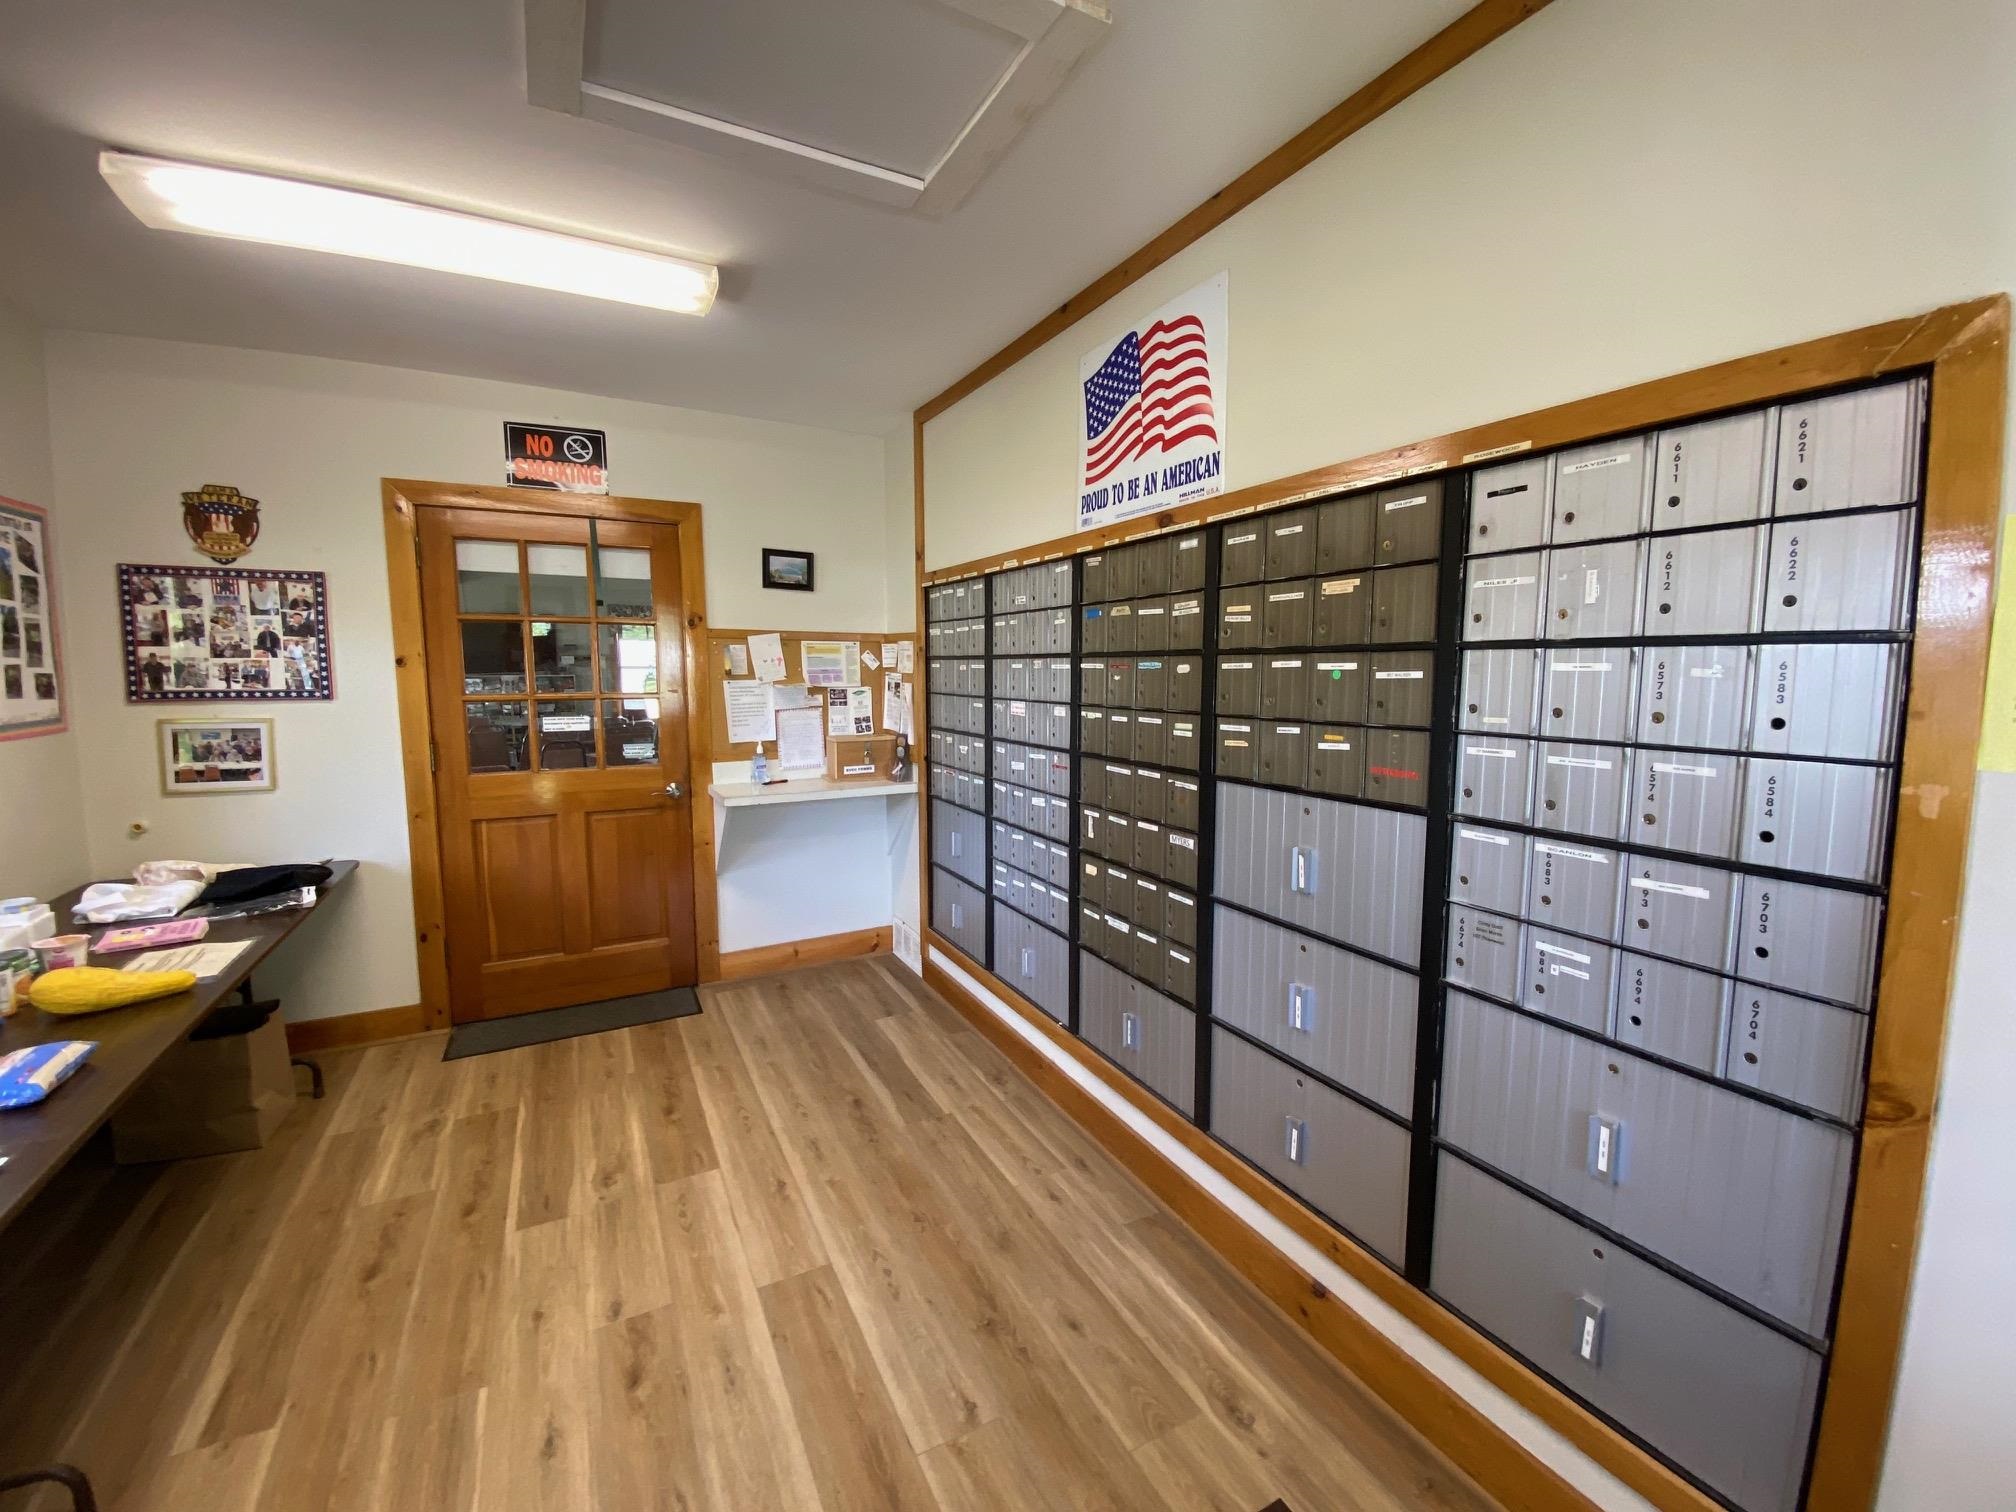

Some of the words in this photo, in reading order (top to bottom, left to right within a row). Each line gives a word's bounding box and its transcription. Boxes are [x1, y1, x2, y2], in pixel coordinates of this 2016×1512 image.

[525, 433, 554, 458] NO
[1798, 418, 1808, 464] 6621
[514, 457, 602, 487] SMOKING
[1081, 487, 1109, 515] PROUD
[1112, 482, 1124, 505] TO
[1128, 477, 1140, 501] BE
[1143, 471, 1158, 497] AN
[1161, 450, 1221, 491] AMERICAN
[1673, 442, 1682, 483] 6611
[1179, 487, 1205, 498] HILLMAN
[1663, 550, 1673, 591] 6612
[1788, 536, 1799, 581] 6622
[1655, 661, 1665, 700] 6573
[1776, 661, 1787, 705] 6583
[1765, 775, 1776, 818] 6584
[1641, 870, 1650, 908] 693
[1457, 917, 1465, 948] 6674
[1759, 892, 1770, 934] 6703
[1538, 941, 1546, 975] 684
[1634, 968, 1643, 1005] 6694
[1748, 1000, 1759, 1041] 6704
